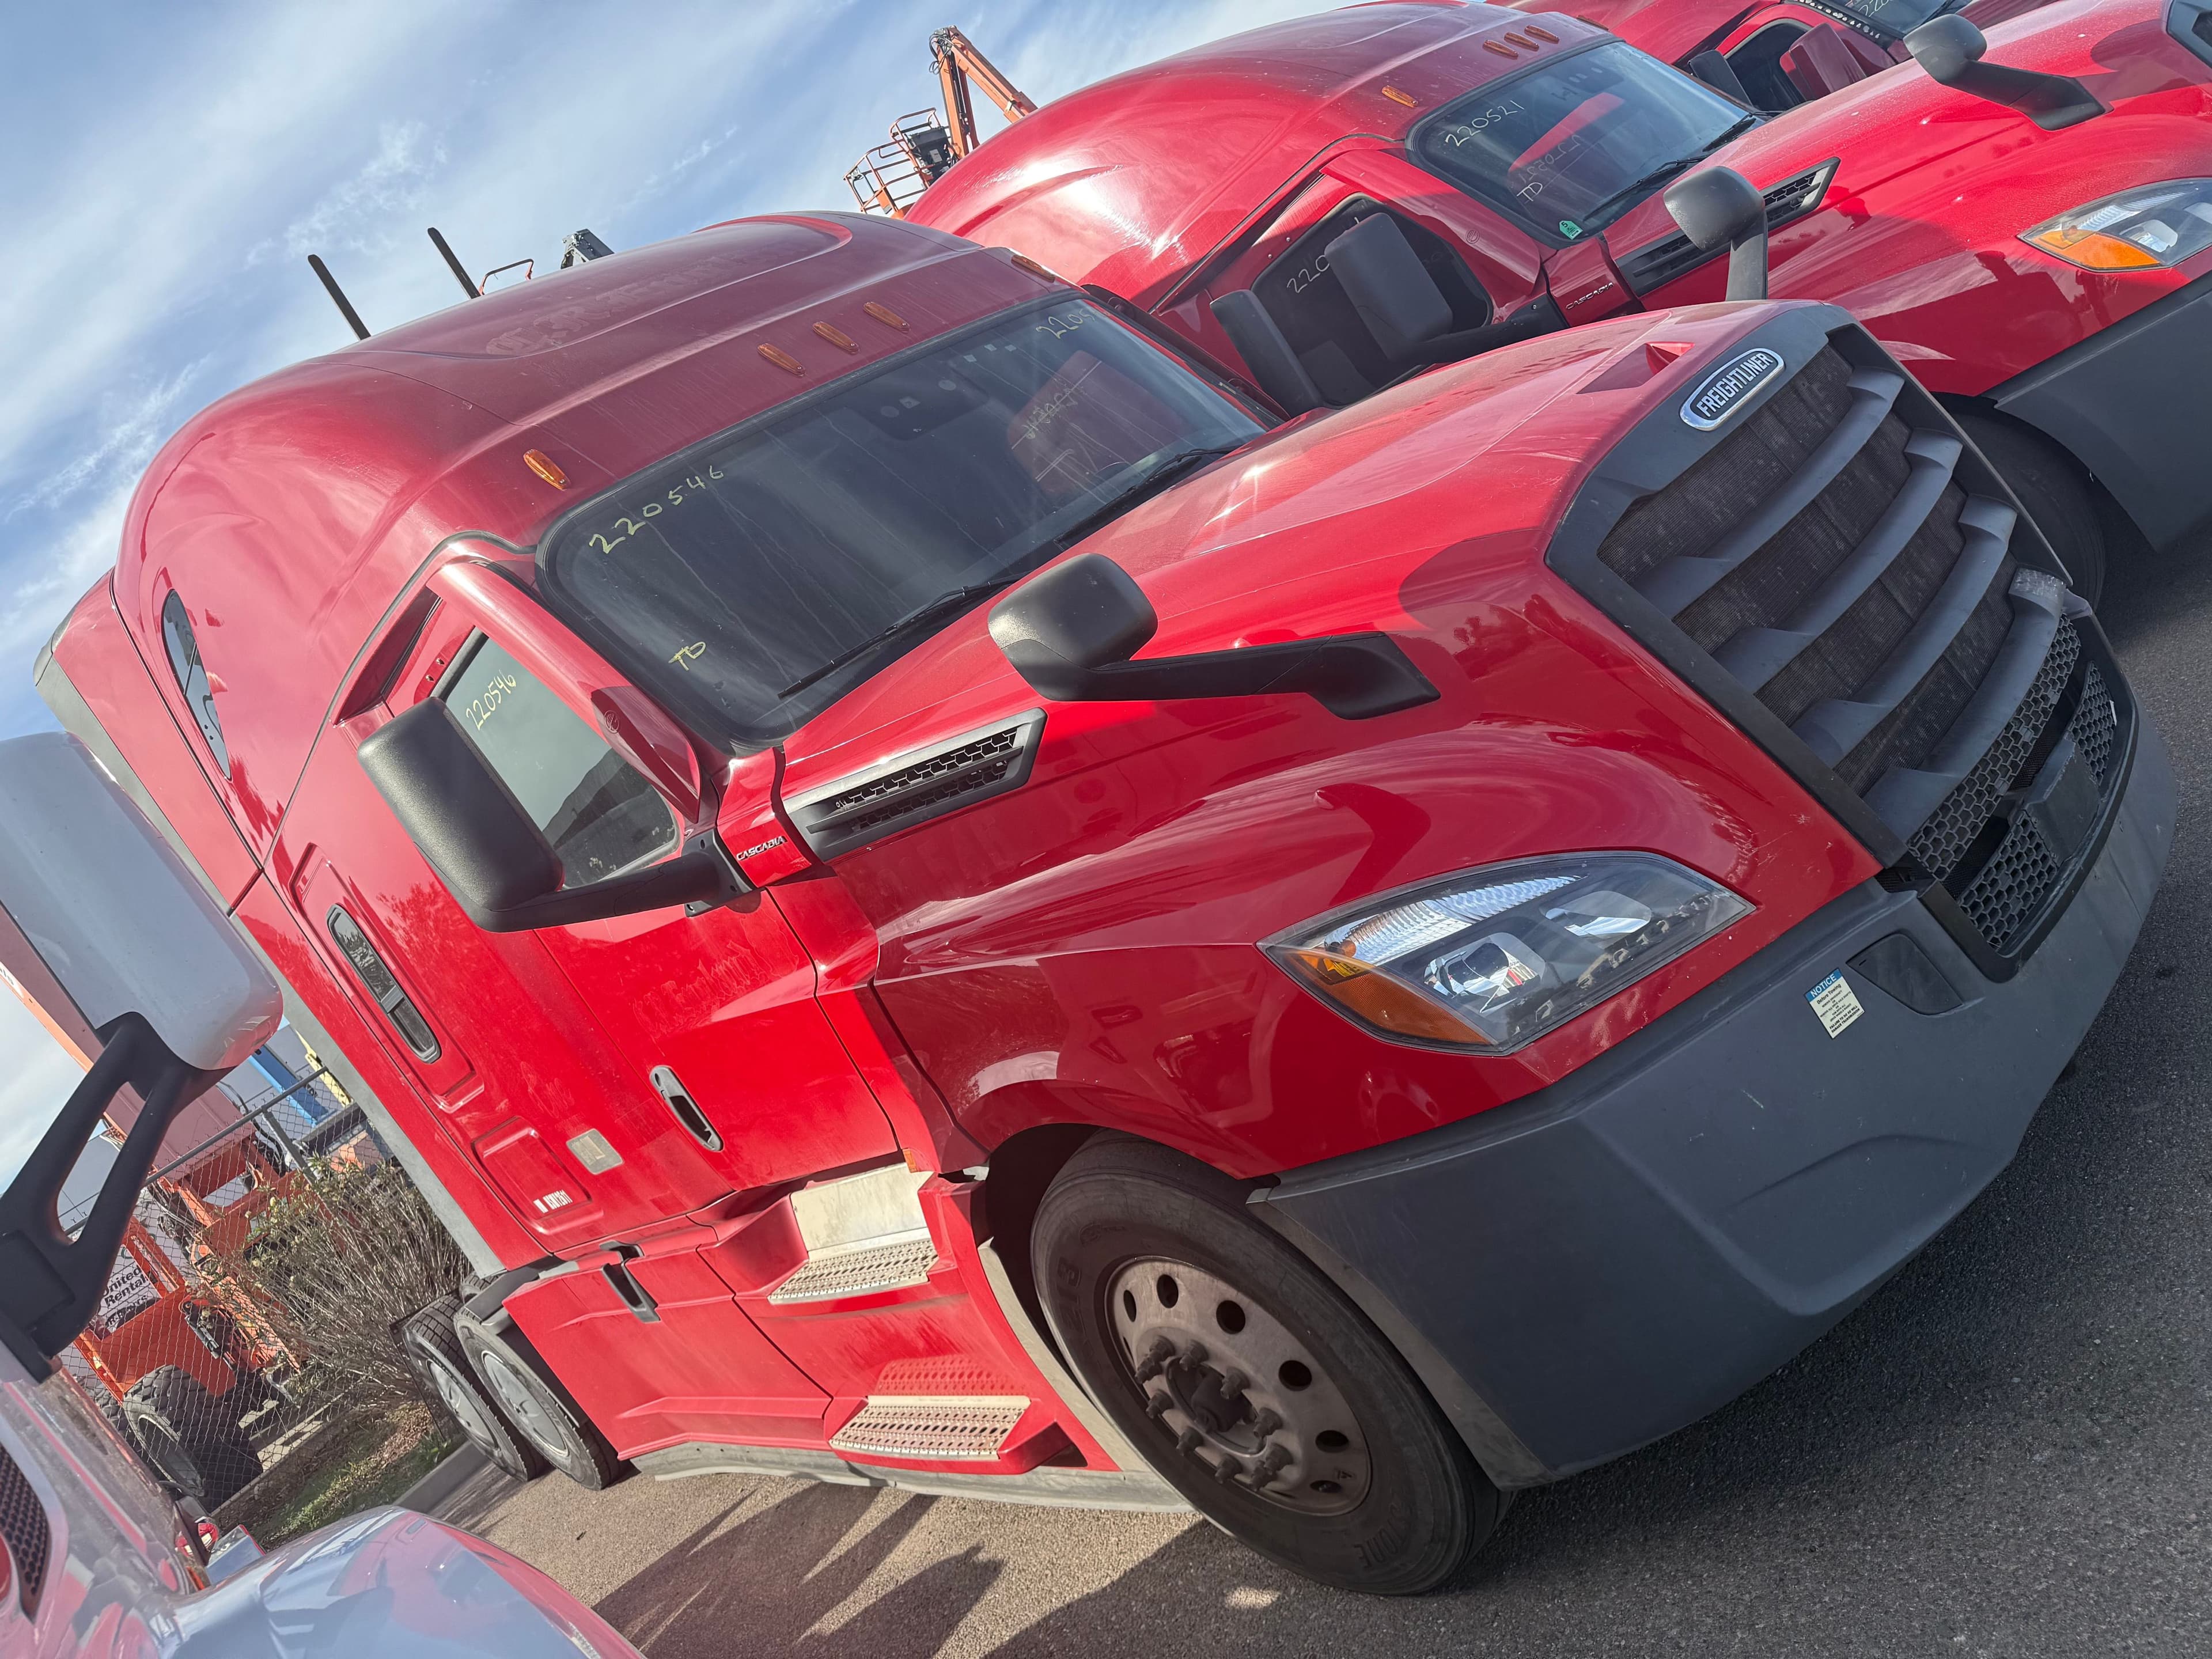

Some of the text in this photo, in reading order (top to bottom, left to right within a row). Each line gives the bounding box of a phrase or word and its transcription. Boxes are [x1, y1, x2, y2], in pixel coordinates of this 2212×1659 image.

[1445, 100, 1525, 147] 220521
[1516, 181, 1543, 202] TD
[1565, 282, 1613, 310] CASCADIA
[1696, 353, 1774, 418] FREIGHTLINER
[589, 465, 724, 554] 220546
[668, 641, 707, 671] TD
[465, 669, 517, 731] 220546
[736, 835, 787, 861] CASCADIA
[1810, 974, 1837, 998] NOTICE
[1816, 983, 1842, 1005] Before Towing
[104, 1274, 149, 1306] Rental
